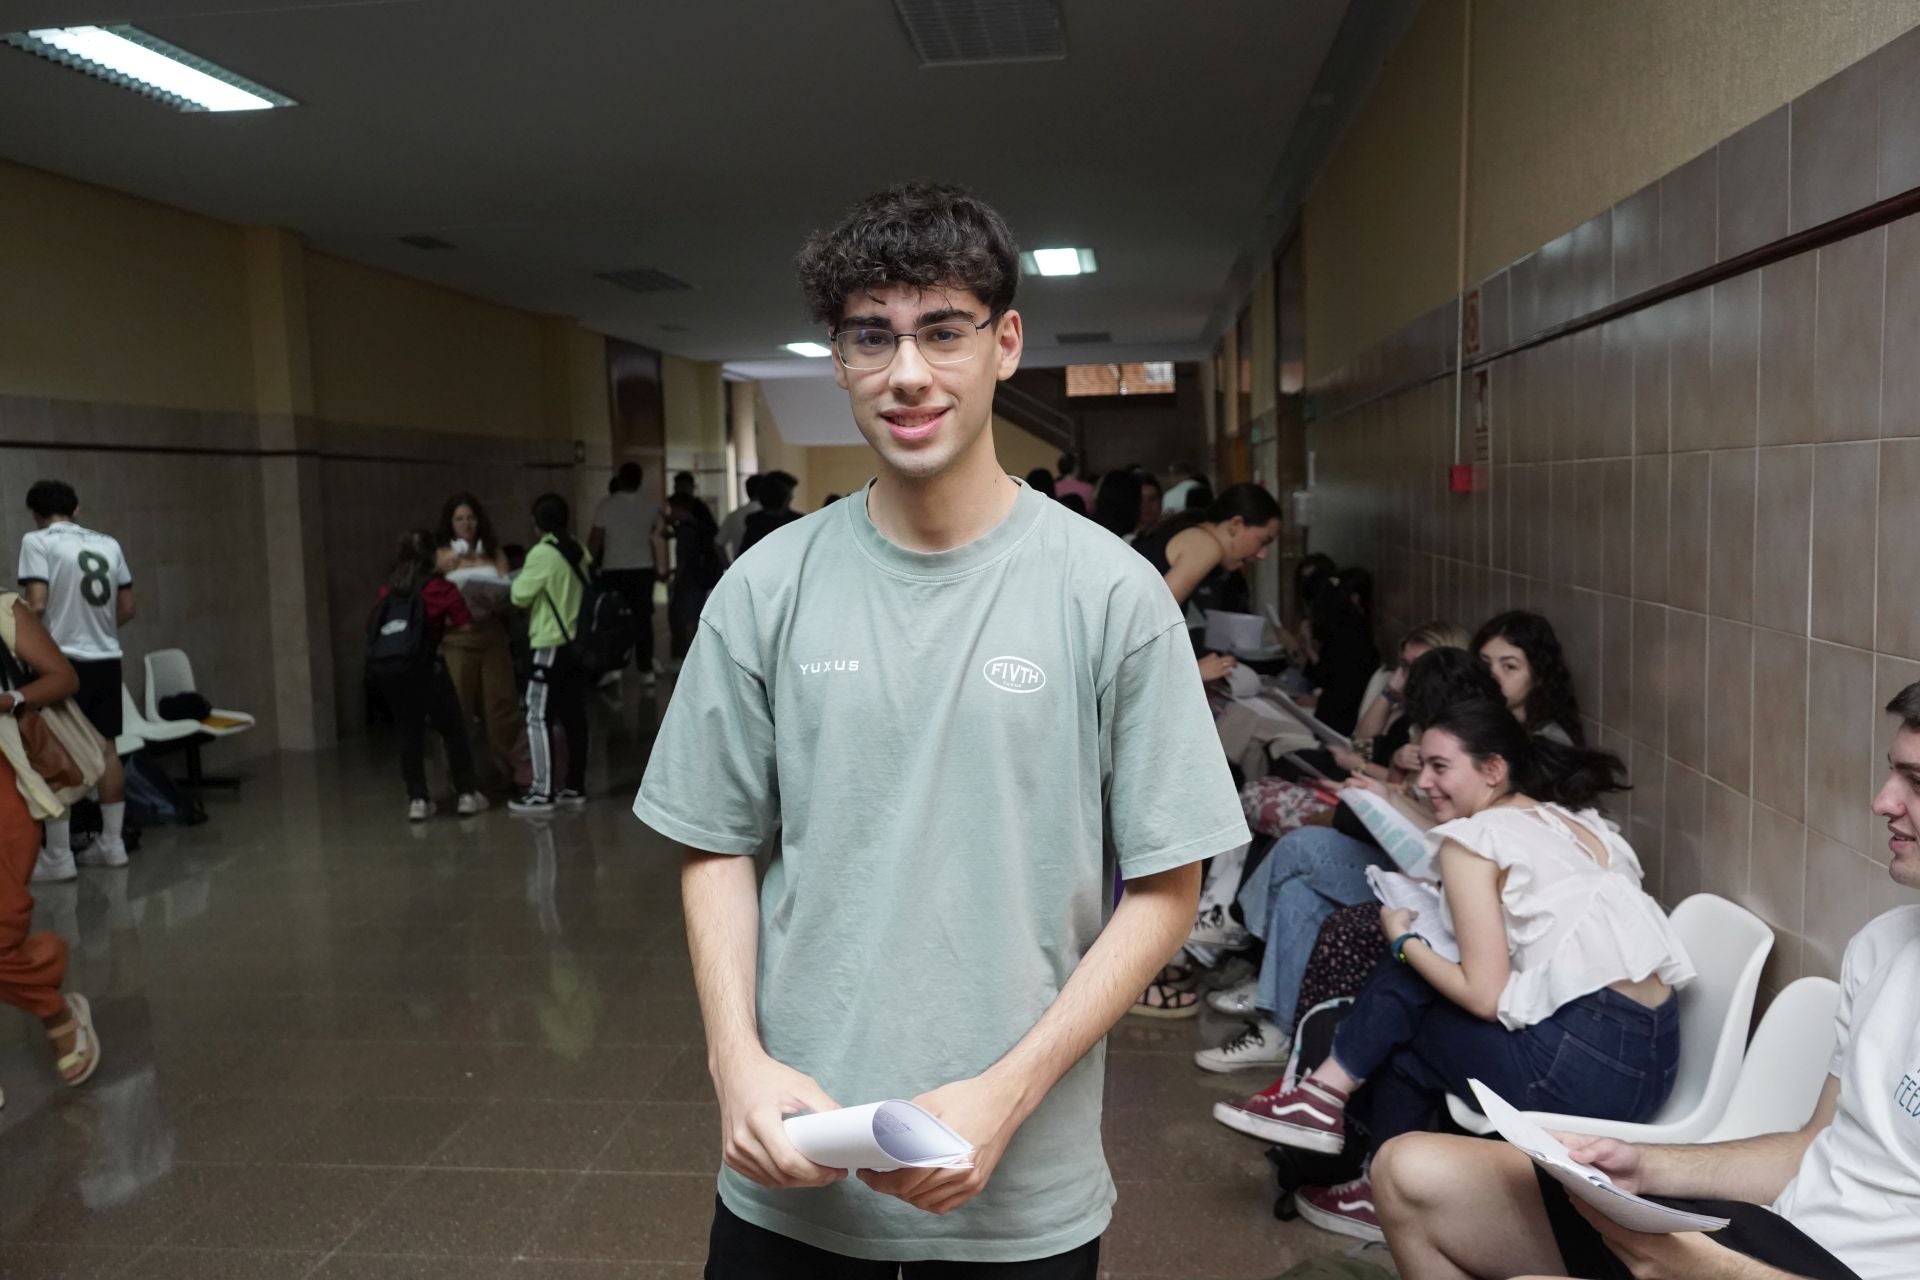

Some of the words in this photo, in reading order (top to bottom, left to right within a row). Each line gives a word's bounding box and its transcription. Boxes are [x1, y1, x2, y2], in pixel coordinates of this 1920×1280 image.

[78, 550, 111, 607] 8
[799, 659, 859, 675] YUXUS
[991, 662, 1039, 684] FIVTH
